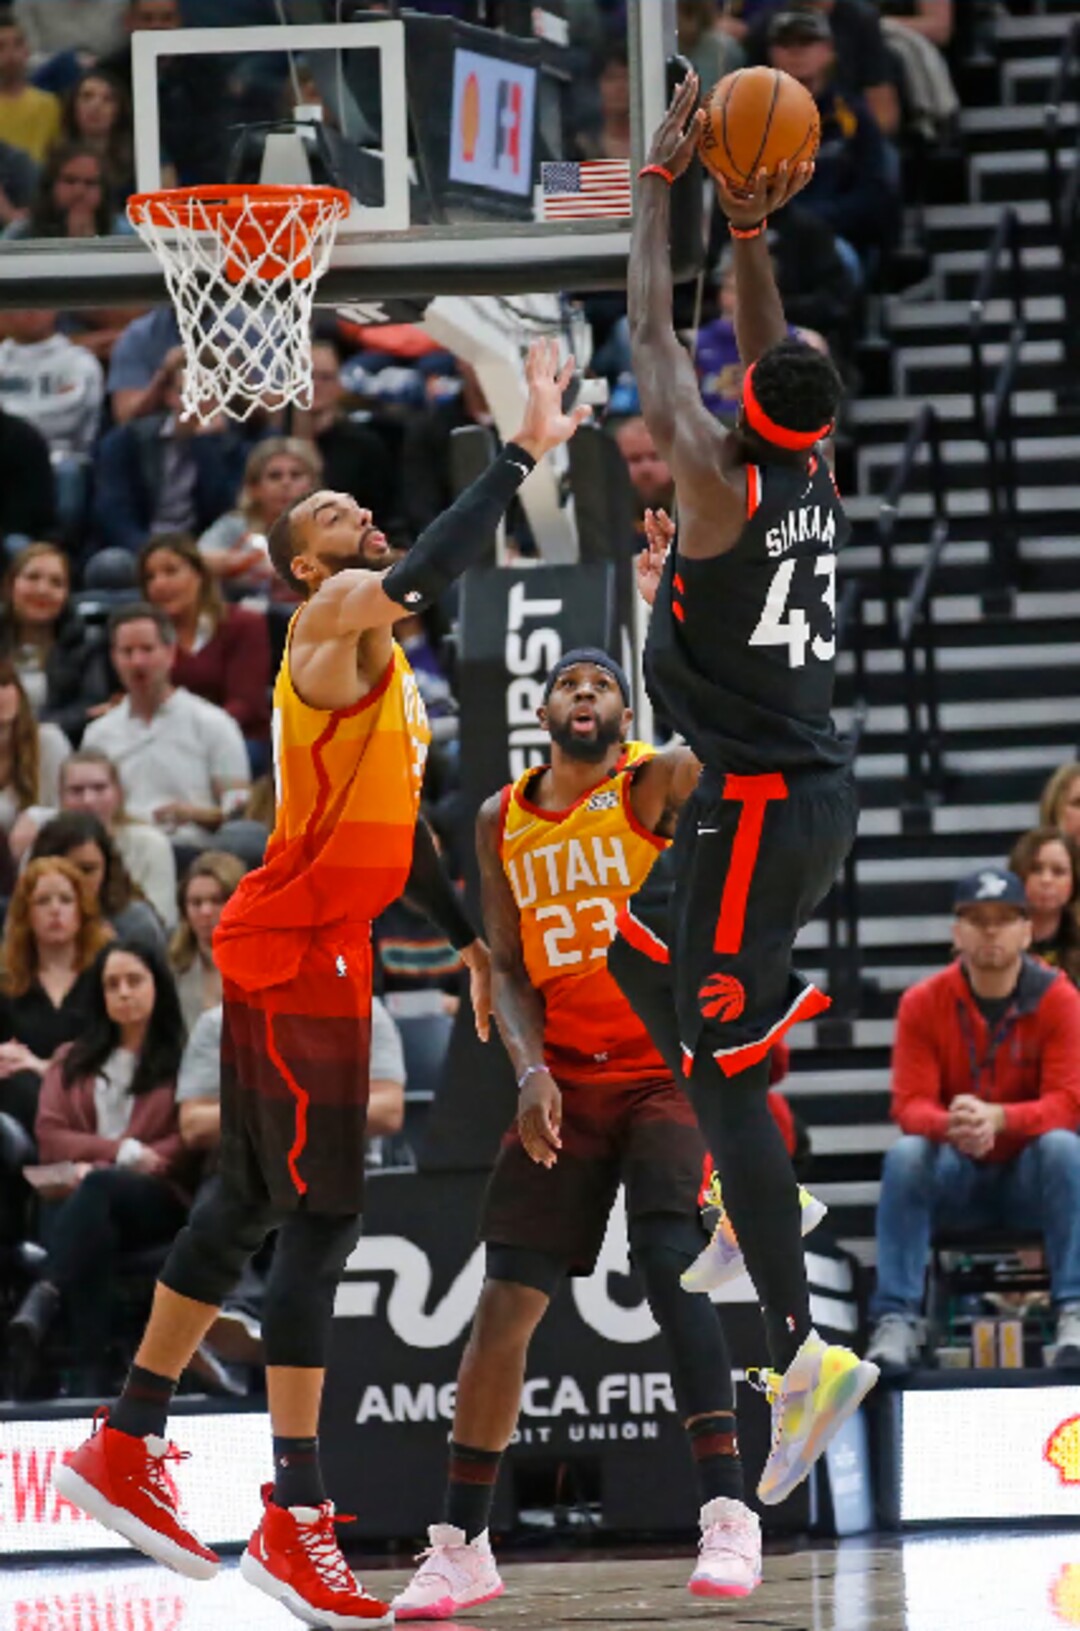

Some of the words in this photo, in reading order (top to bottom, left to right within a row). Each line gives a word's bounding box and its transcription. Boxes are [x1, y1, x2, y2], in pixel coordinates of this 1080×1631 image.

[748, 554, 836, 668] 43
[508, 836, 631, 908] UTAH
[536, 897, 618, 967] 23
[355, 1375, 590, 1424] AMECA
[568, 1421, 659, 1442] UNION
